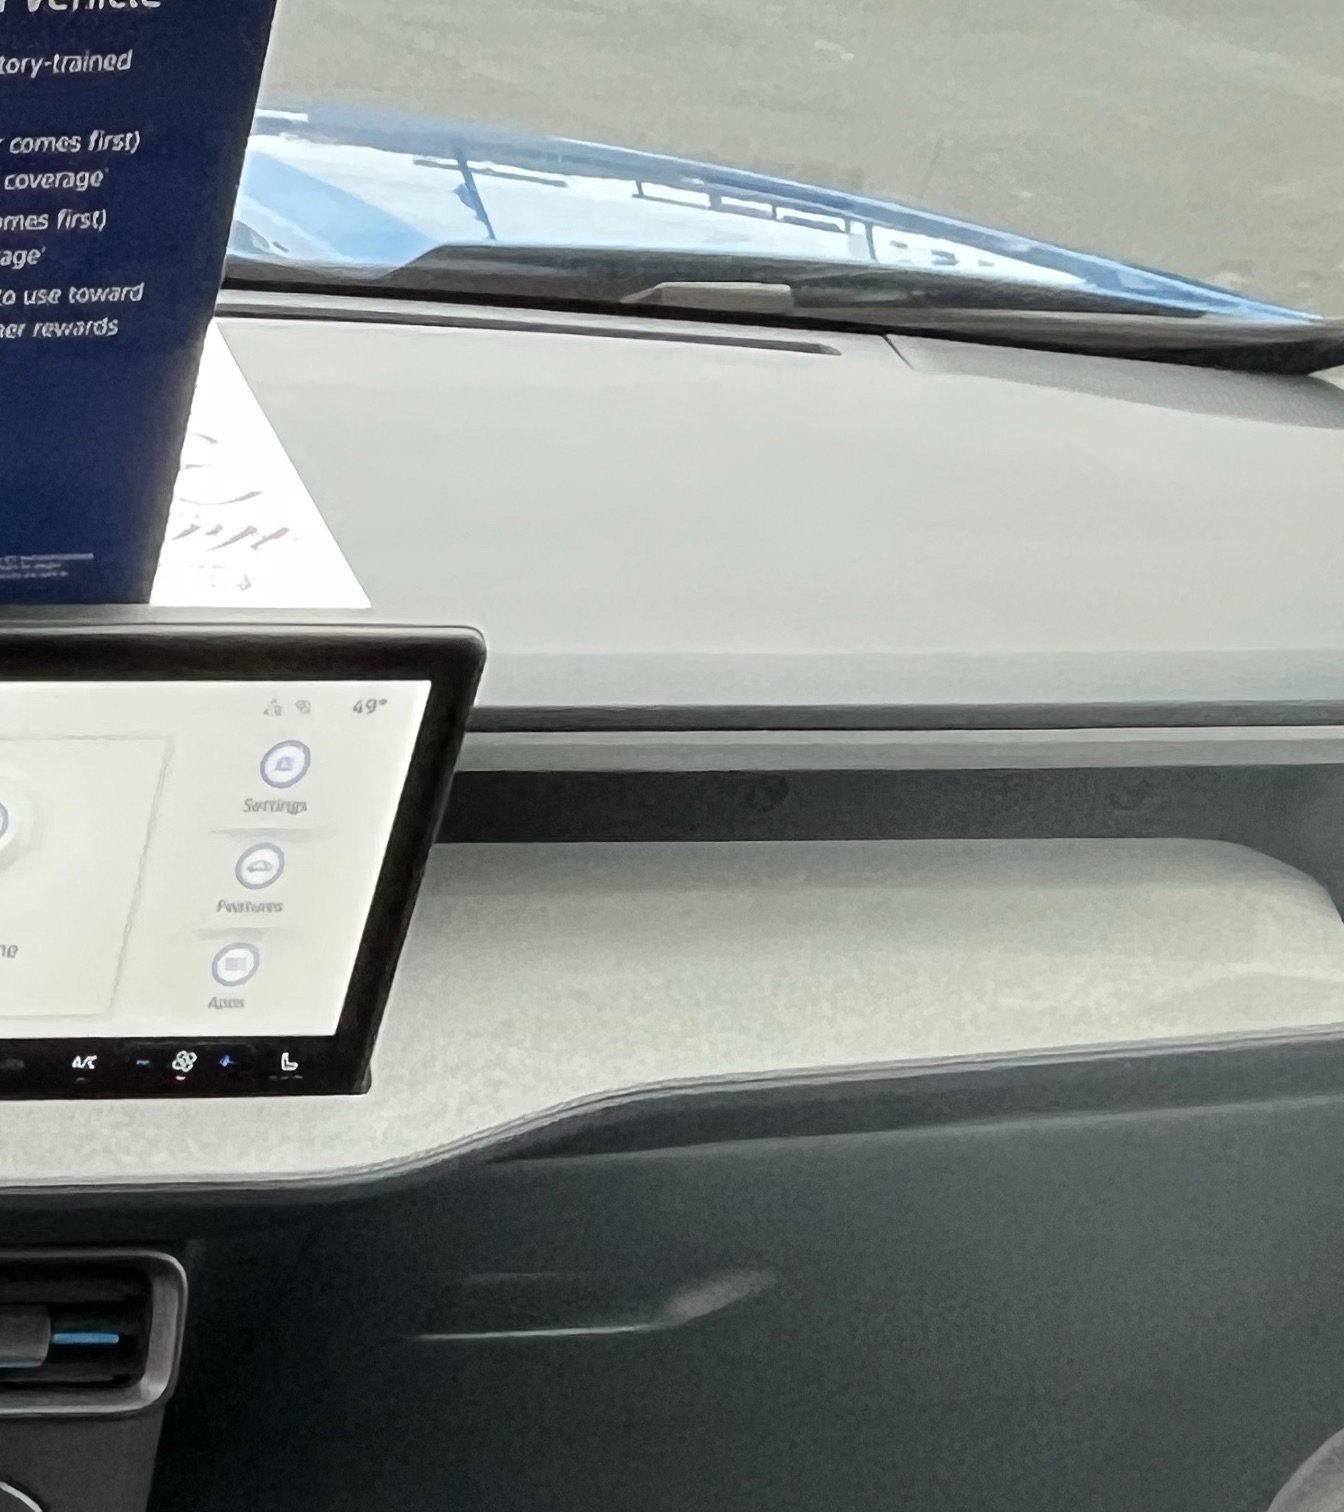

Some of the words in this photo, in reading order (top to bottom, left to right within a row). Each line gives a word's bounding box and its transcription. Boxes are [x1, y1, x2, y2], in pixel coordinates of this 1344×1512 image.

[9, 135, 81, 154] comes
[88, 129, 141, 154] first)
[57, 208, 107, 232] first)
[23, 288, 62, 306] use
[68, 282, 145, 304] toward
[32, 315, 119, 338] rewards
[243, 799, 307, 815] Settings
